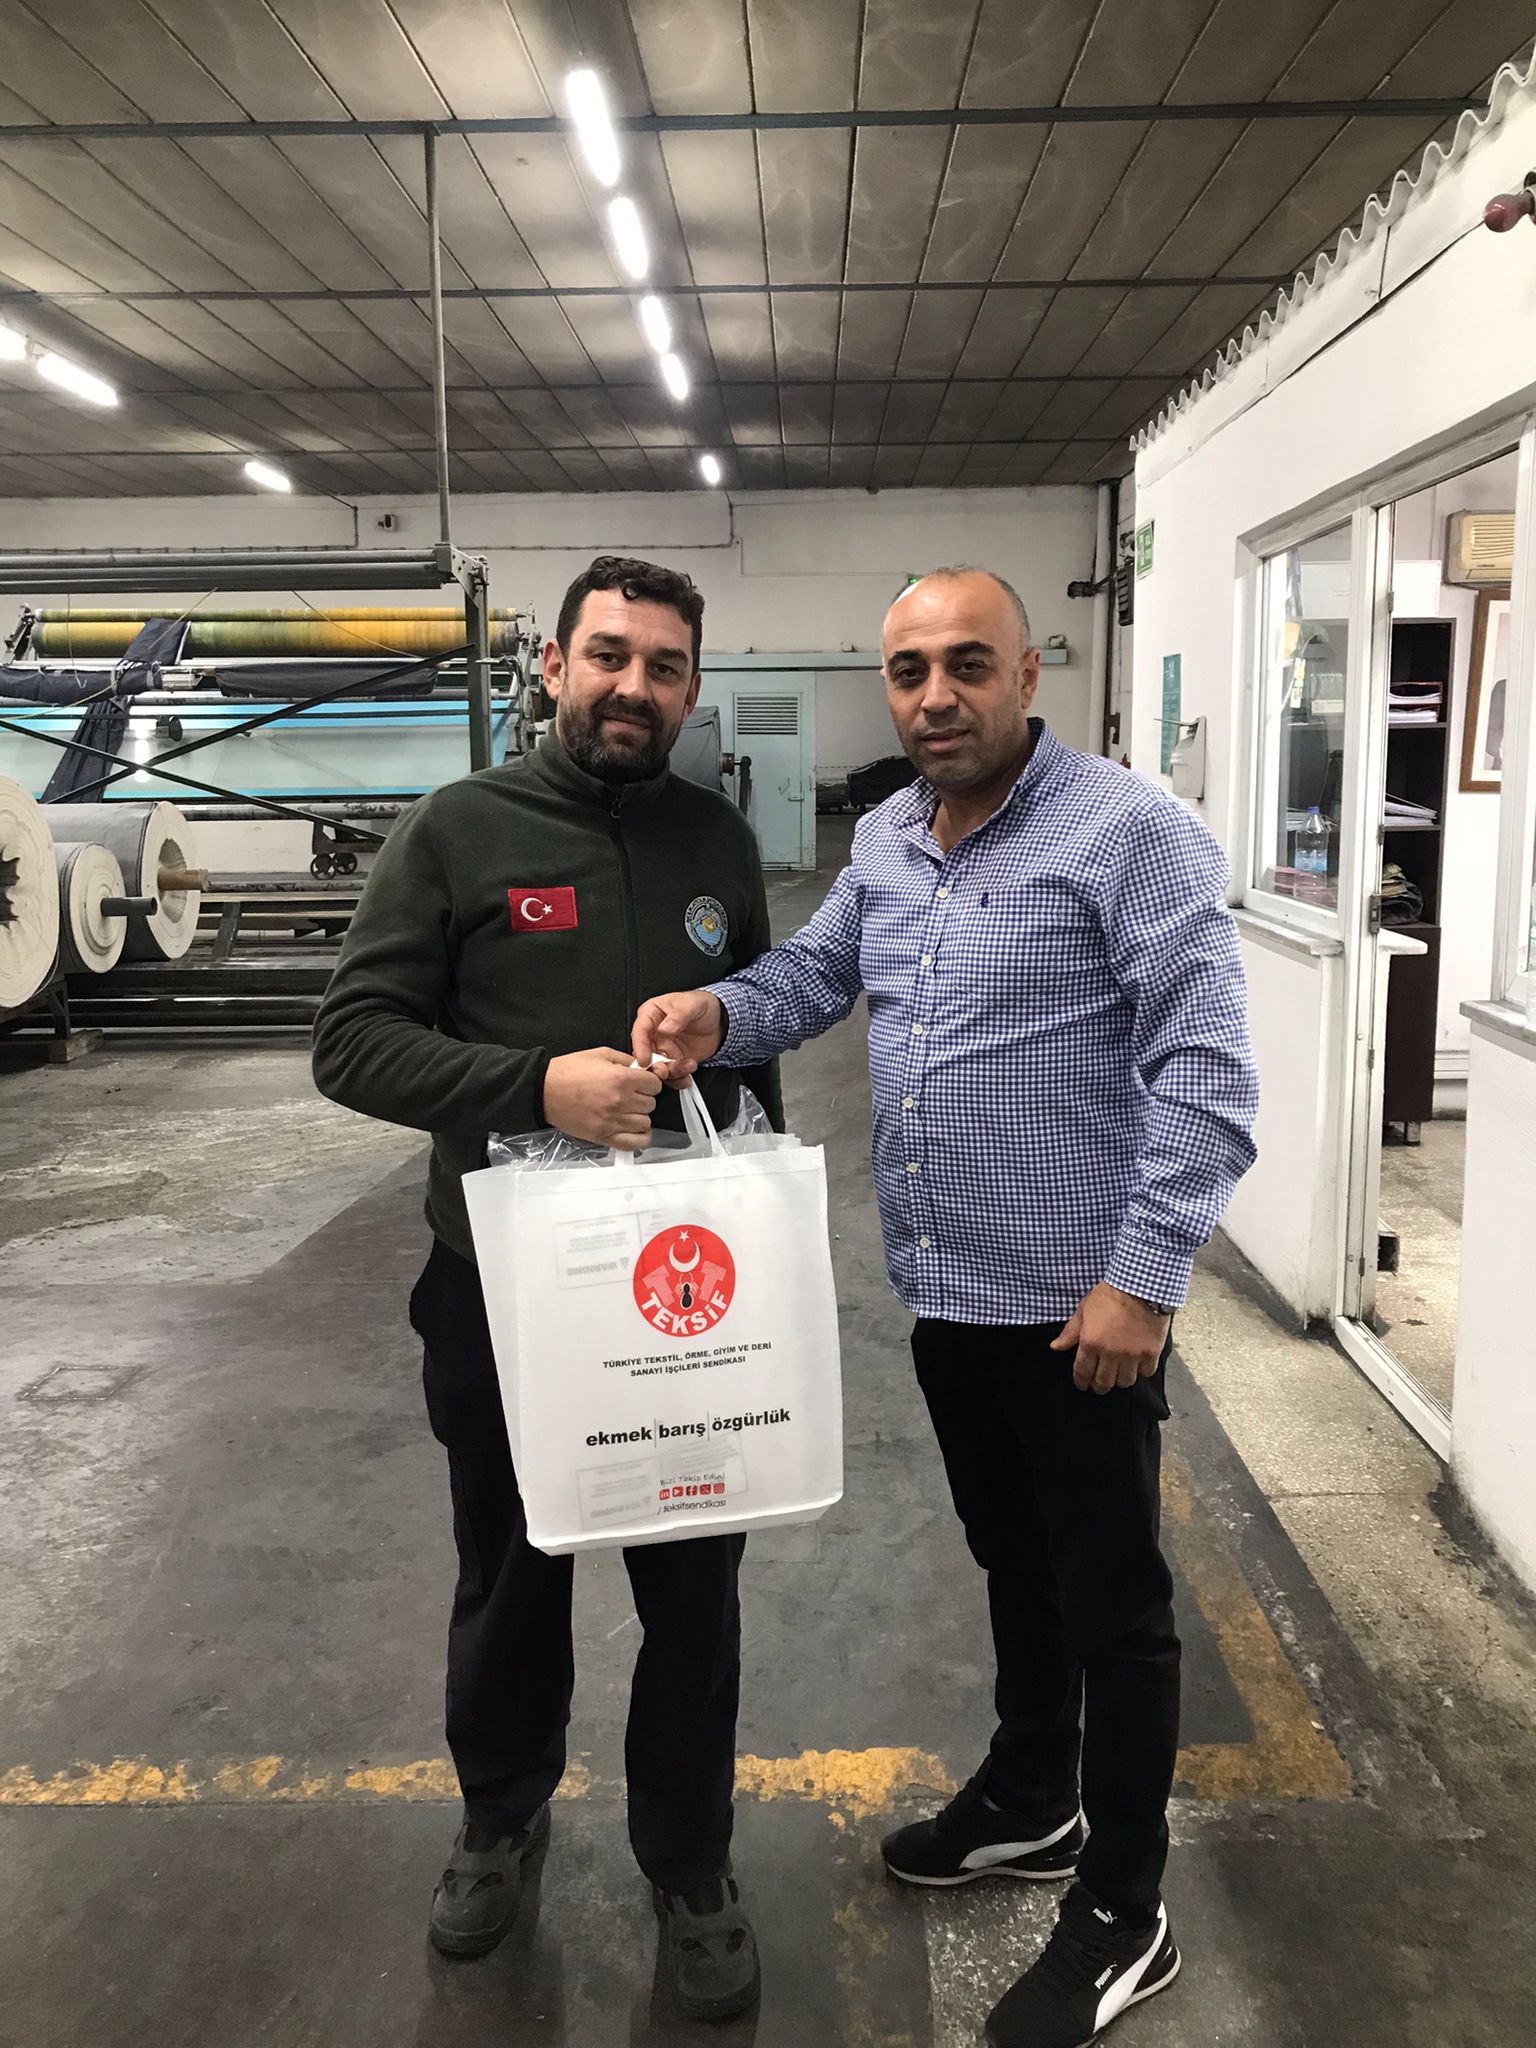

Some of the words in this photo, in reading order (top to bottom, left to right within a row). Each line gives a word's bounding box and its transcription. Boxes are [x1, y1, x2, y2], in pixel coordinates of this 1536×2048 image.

[603, 1357, 642, 1369] TÜRKİYE
[644, 1353, 683, 1365] TEKSTİL,
[685, 1349, 712, 1360] ÖRME,
[713, 1346, 736, 1356] GİYİM
[738, 1344, 749, 1352] VE
[751, 1341, 772, 1351] DERİ
[630, 1366, 663, 1377] SANAYİ
[665, 1362, 701, 1374] İŞÇİLERİ
[702, 1355, 746, 1369] SENDİKASI
[586, 1426, 653, 1446] ekmek
[658, 1421, 706, 1437] barış
[712, 1408, 791, 1432] özgürlük
